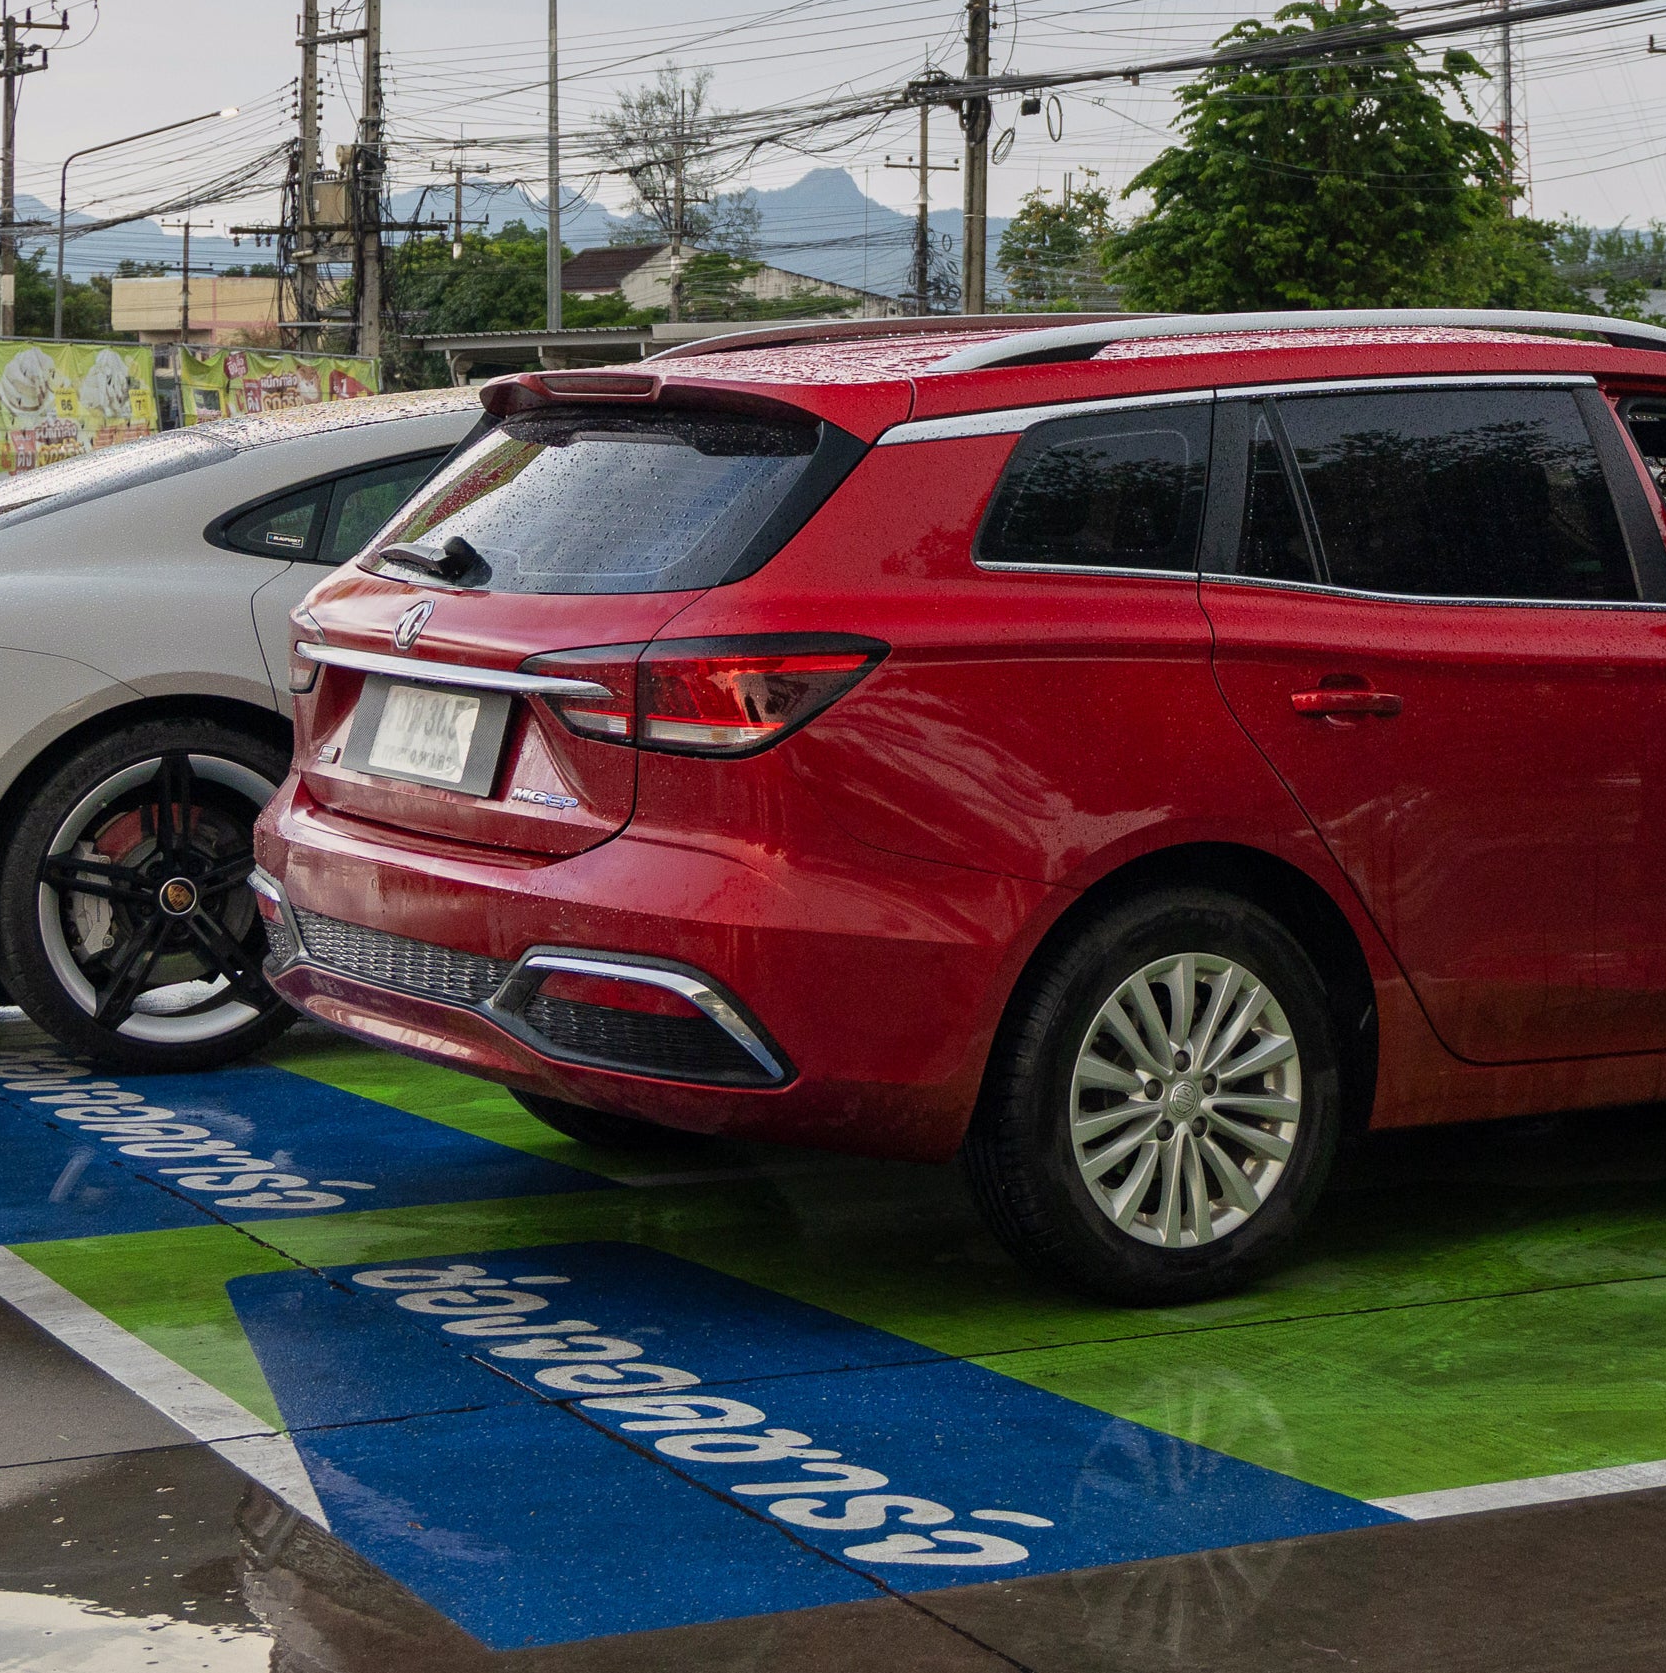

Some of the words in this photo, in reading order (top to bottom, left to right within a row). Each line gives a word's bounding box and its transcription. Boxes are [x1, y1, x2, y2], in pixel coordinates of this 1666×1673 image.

[351, 1264, 1054, 1567] ช่องจอดชาร์จ
